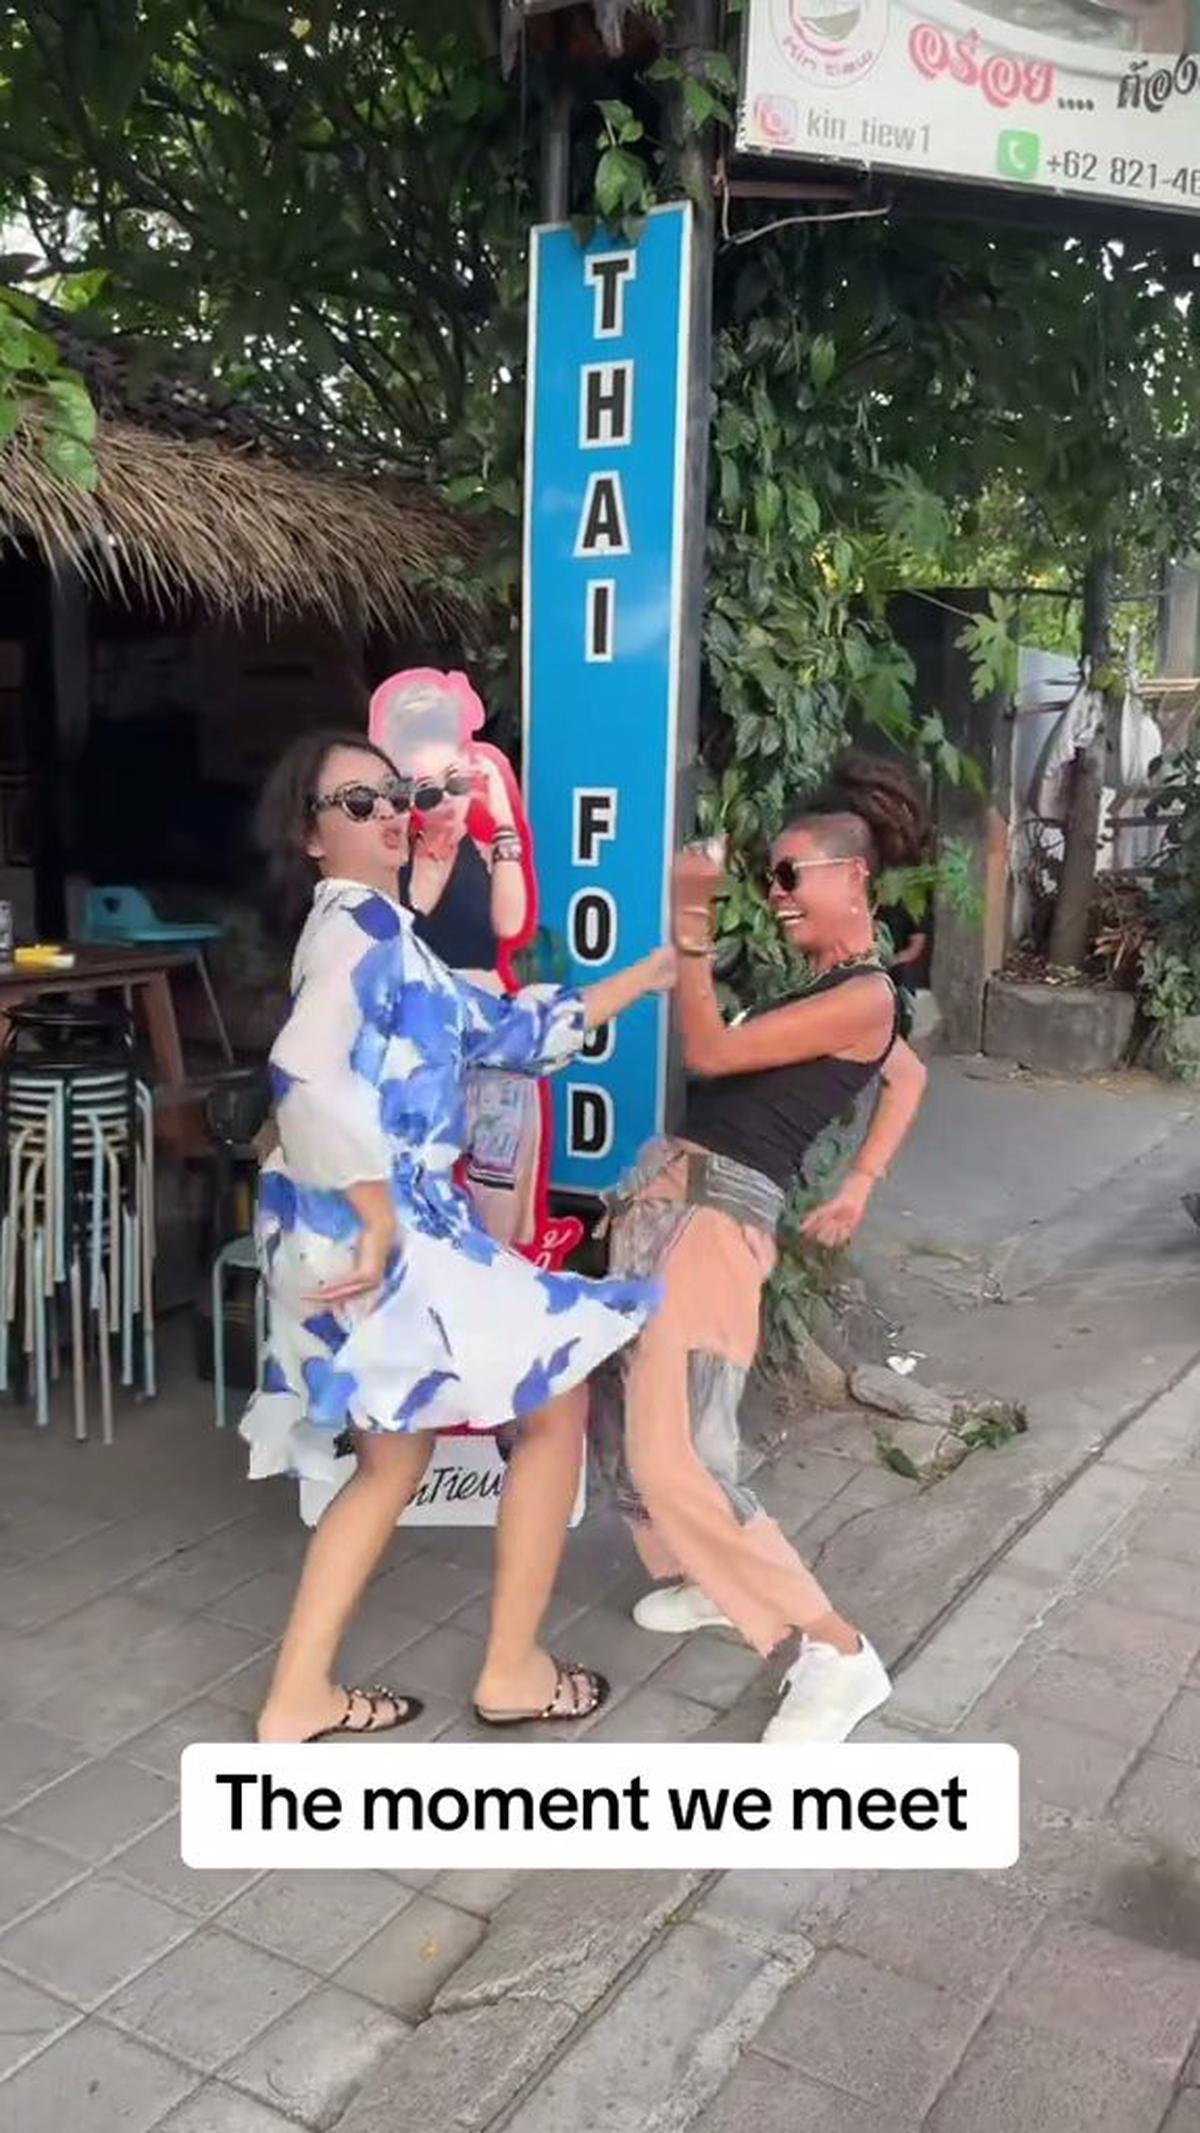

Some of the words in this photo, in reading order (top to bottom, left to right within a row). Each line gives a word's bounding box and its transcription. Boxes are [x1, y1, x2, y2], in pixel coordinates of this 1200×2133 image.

[807, 106, 932, 154] kin_tiew1
[1046, 150, 1098, 181] +62
[574, 250, 636, 662] THAI
